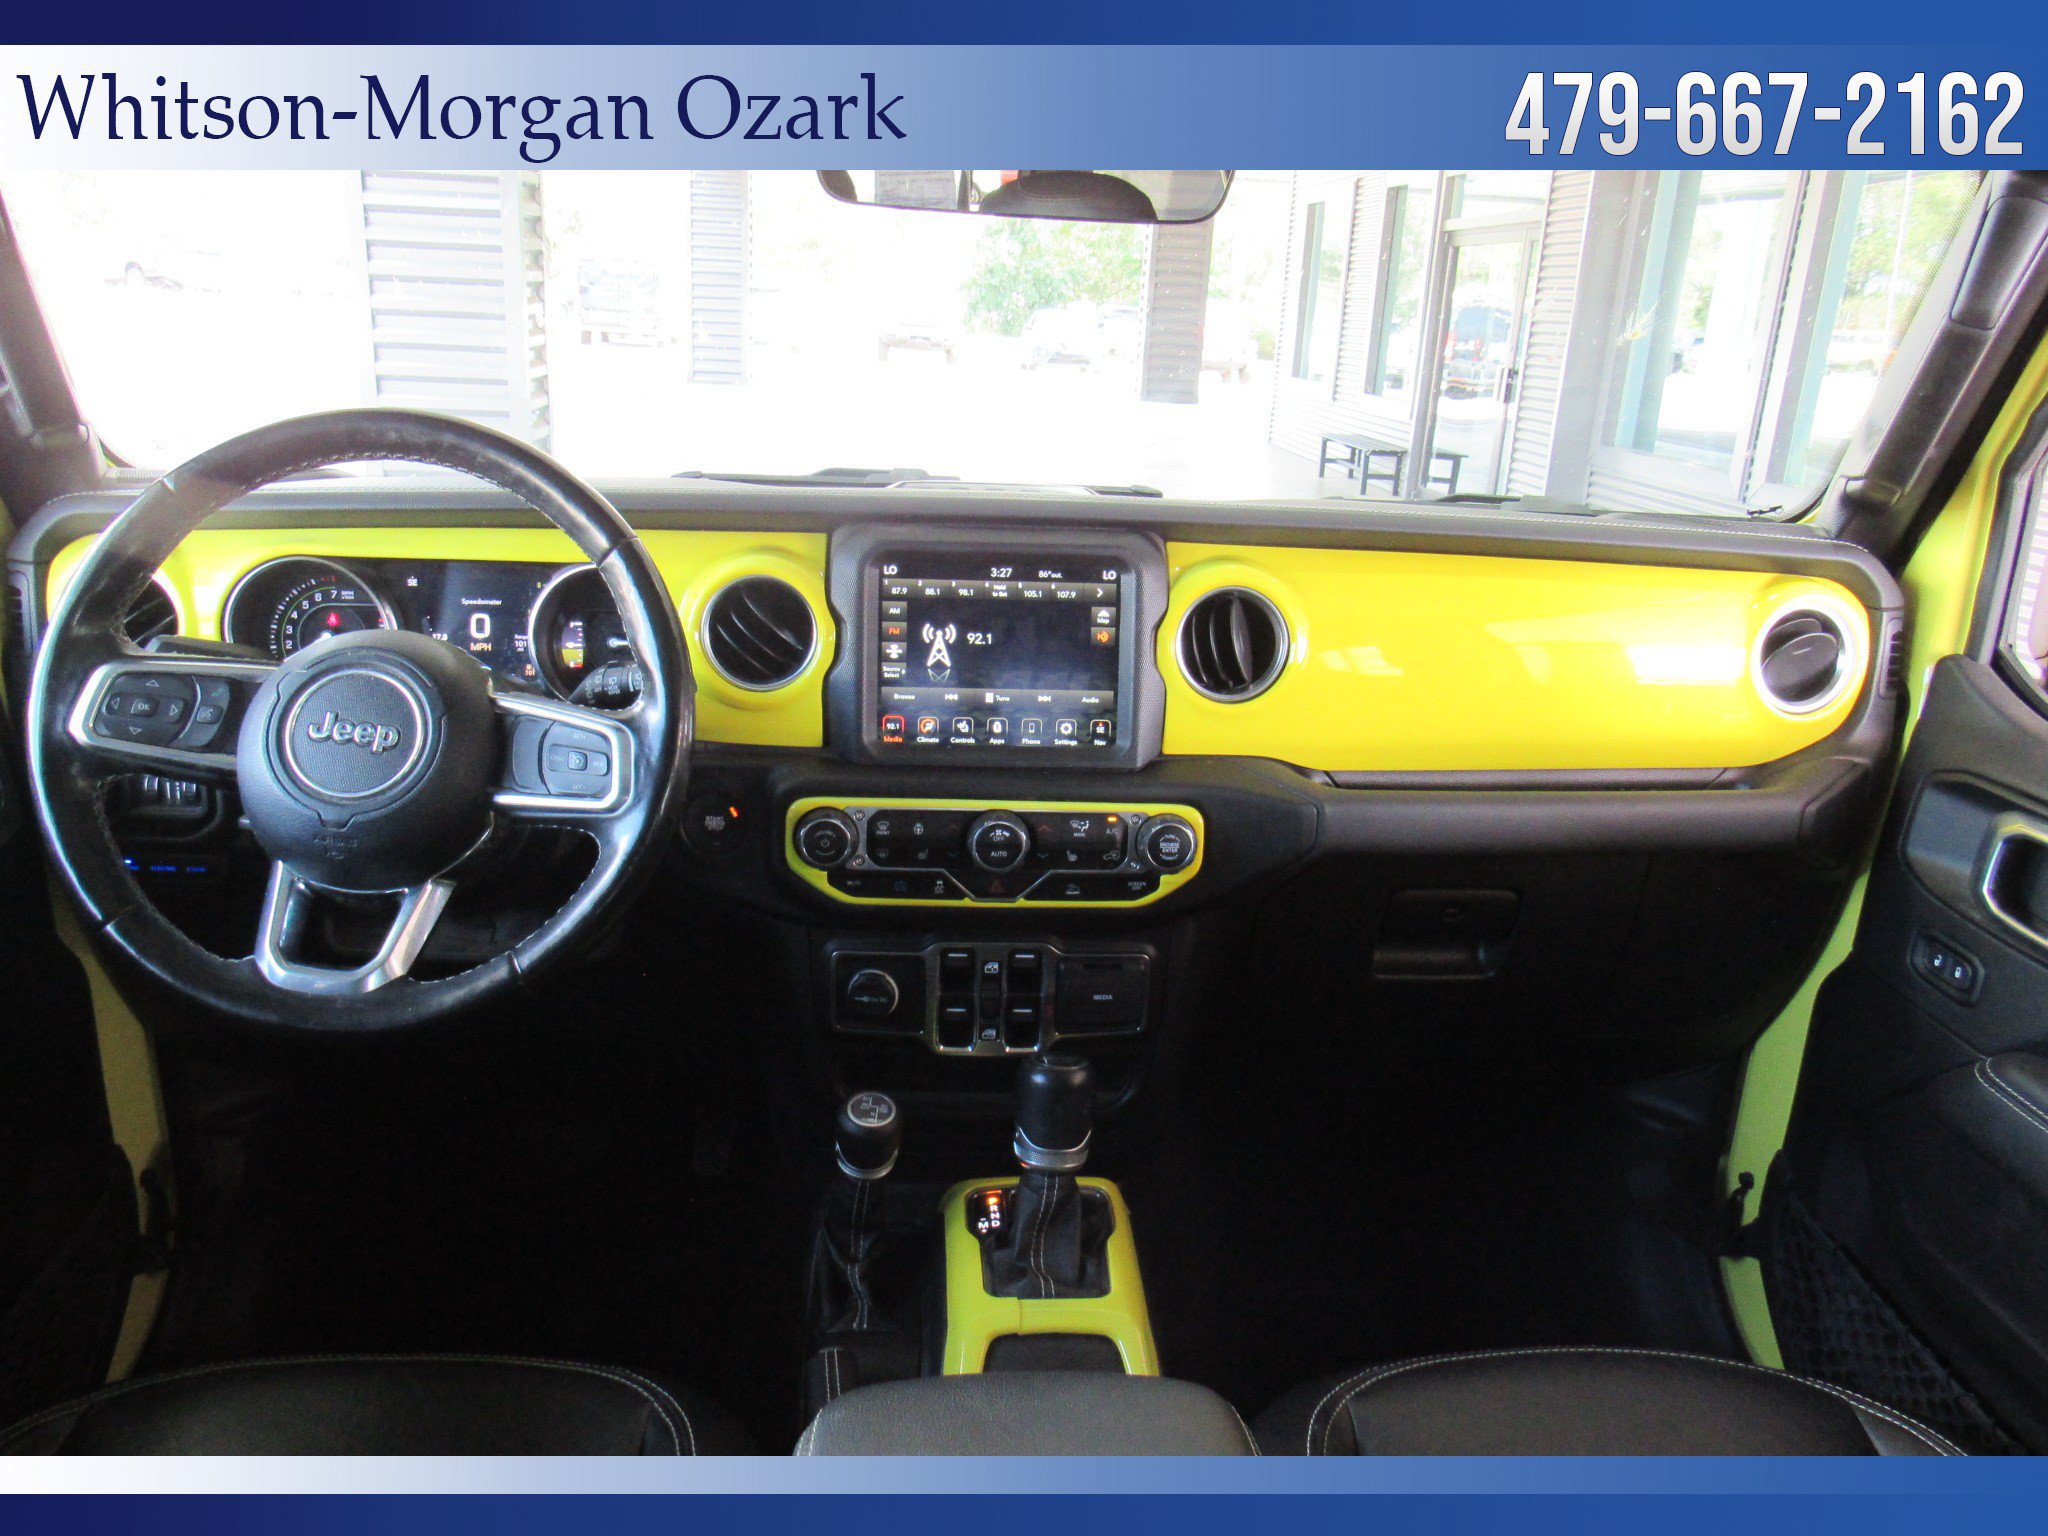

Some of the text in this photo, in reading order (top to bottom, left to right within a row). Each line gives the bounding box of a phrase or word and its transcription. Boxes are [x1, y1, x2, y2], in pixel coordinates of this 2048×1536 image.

[883, 565, 898, 575] LO
[990, 567, 1013, 578] 3:27
[1102, 569, 1117, 580] LO
[330, 590, 338, 599] 7
[891, 586, 908, 595] 87.9
[924, 587, 941, 596] 88.1
[958, 588, 974, 597] 98.1
[1023, 590, 1043, 598] 105.1
[1056, 590, 1077, 599] 107.9
[315, 592, 322, 602] 6
[461, 597, 503, 606] Speedometer
[302, 600, 310, 610] 5
[290, 610, 299, 620] 4
[888, 607, 901, 615] AM
[286, 625, 293, 635] 3
[470, 613, 491, 639] 0
[888, 627, 900, 635] FM
[966, 632, 993, 645] 92.1
[285, 640, 293, 650] 2
[470, 642, 492, 652] MPH
[893, 692, 916, 700] Browse
[1081, 696, 1100, 704] Audio
[138, 702, 151, 711] OK
[886, 722, 900, 730] 92.1
[308, 710, 401, 755] Jeep
[883, 735, 903, 743] Media
[916, 736, 940, 744] Climate
[950, 736, 976, 744] Controls
[989, 737, 1005, 745] Apps
[1054, 738, 1078, 746] Settings
[988, 1197, 998, 1206] P
[989, 1204, 999, 1212] R
[978, 1221, 989, 1229] M
[991, 1219, 1001, 1228] D
